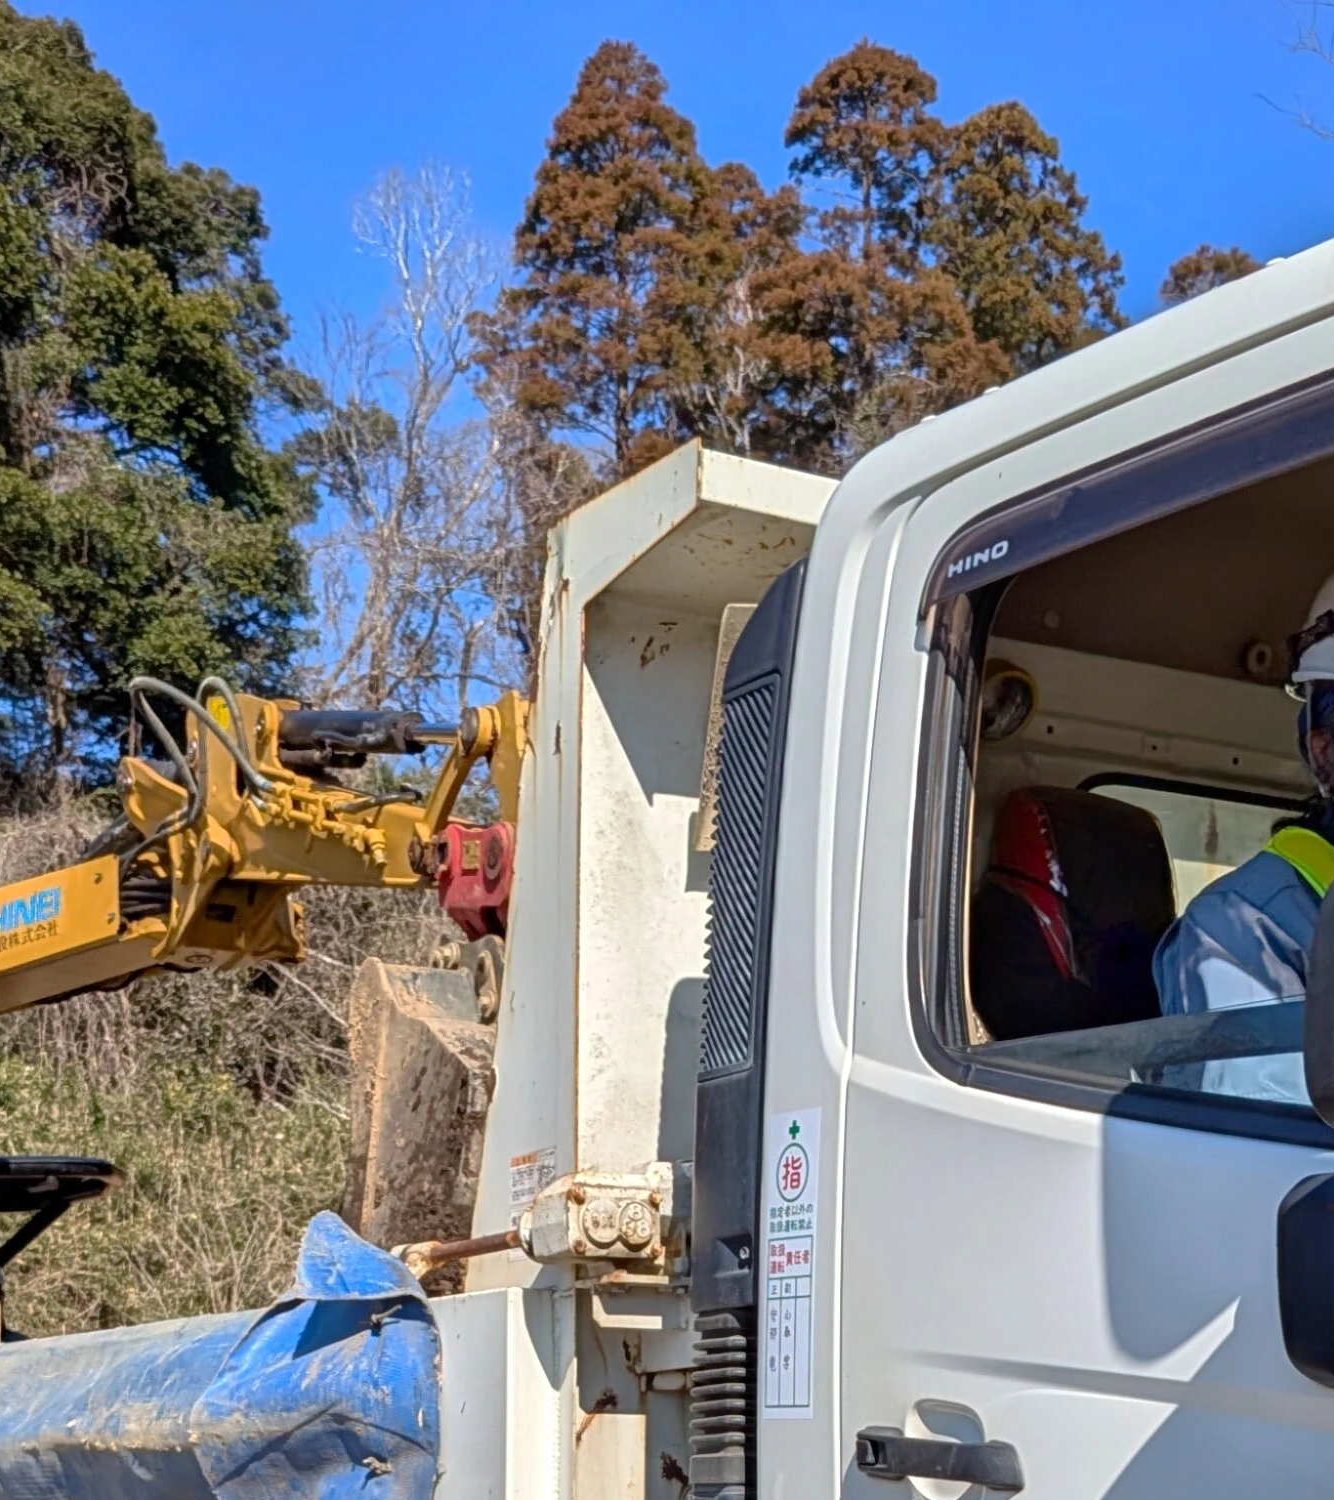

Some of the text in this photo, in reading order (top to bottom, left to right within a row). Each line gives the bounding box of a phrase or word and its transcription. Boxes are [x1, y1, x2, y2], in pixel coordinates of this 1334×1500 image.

[947, 540, 1009, 578] HINO
[782, 1156, 803, 1191] 指
[770, 1203, 814, 1219] 指定者以外の
[786, 1250, 811, 1267] 責任者
